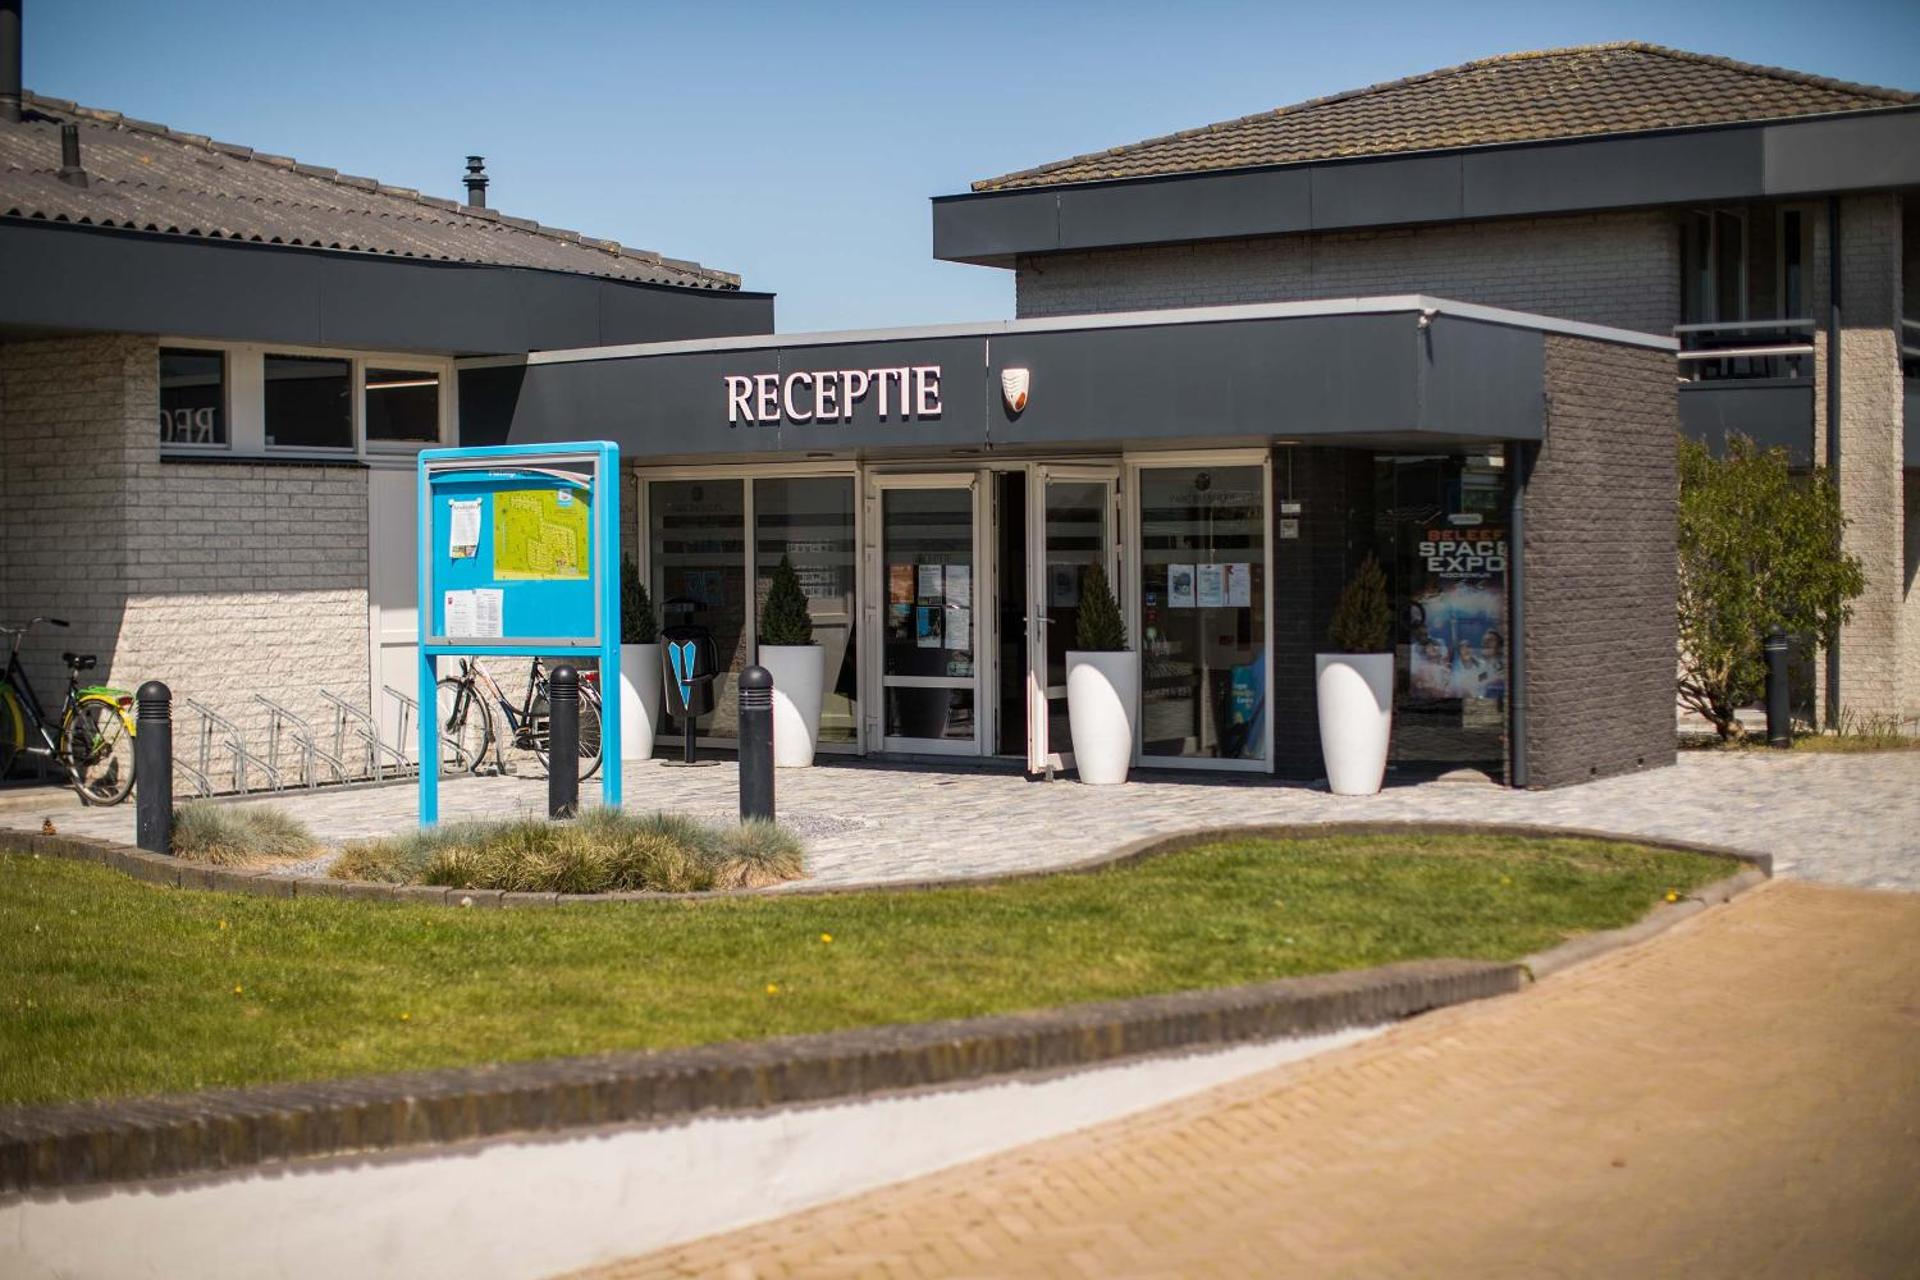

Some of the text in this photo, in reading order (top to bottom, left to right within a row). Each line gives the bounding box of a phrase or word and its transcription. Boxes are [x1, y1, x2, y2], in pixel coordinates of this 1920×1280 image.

[724, 365, 942, 421] RECEPTIE
[1427, 529, 1504, 541] BELEEF
[1427, 556, 1505, 572] EXPO
